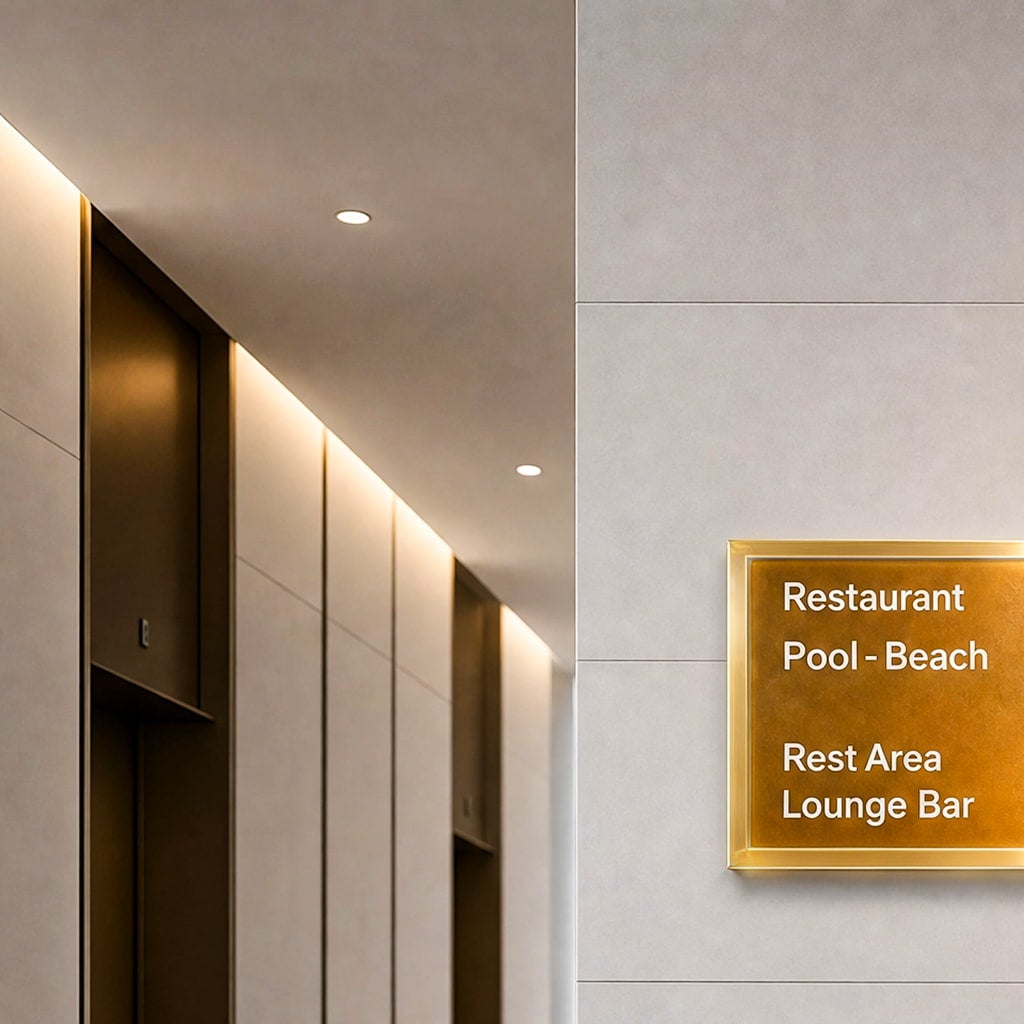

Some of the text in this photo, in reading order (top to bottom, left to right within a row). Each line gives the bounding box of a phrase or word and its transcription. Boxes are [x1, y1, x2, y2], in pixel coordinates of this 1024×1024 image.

[784, 581, 965, 612] Restaurant
[784, 641, 858, 671] Pool
[885, 641, 988, 671] Beach
[783, 742, 942, 772] Rest Area
[783, 789, 975, 827] Lounge Bar
